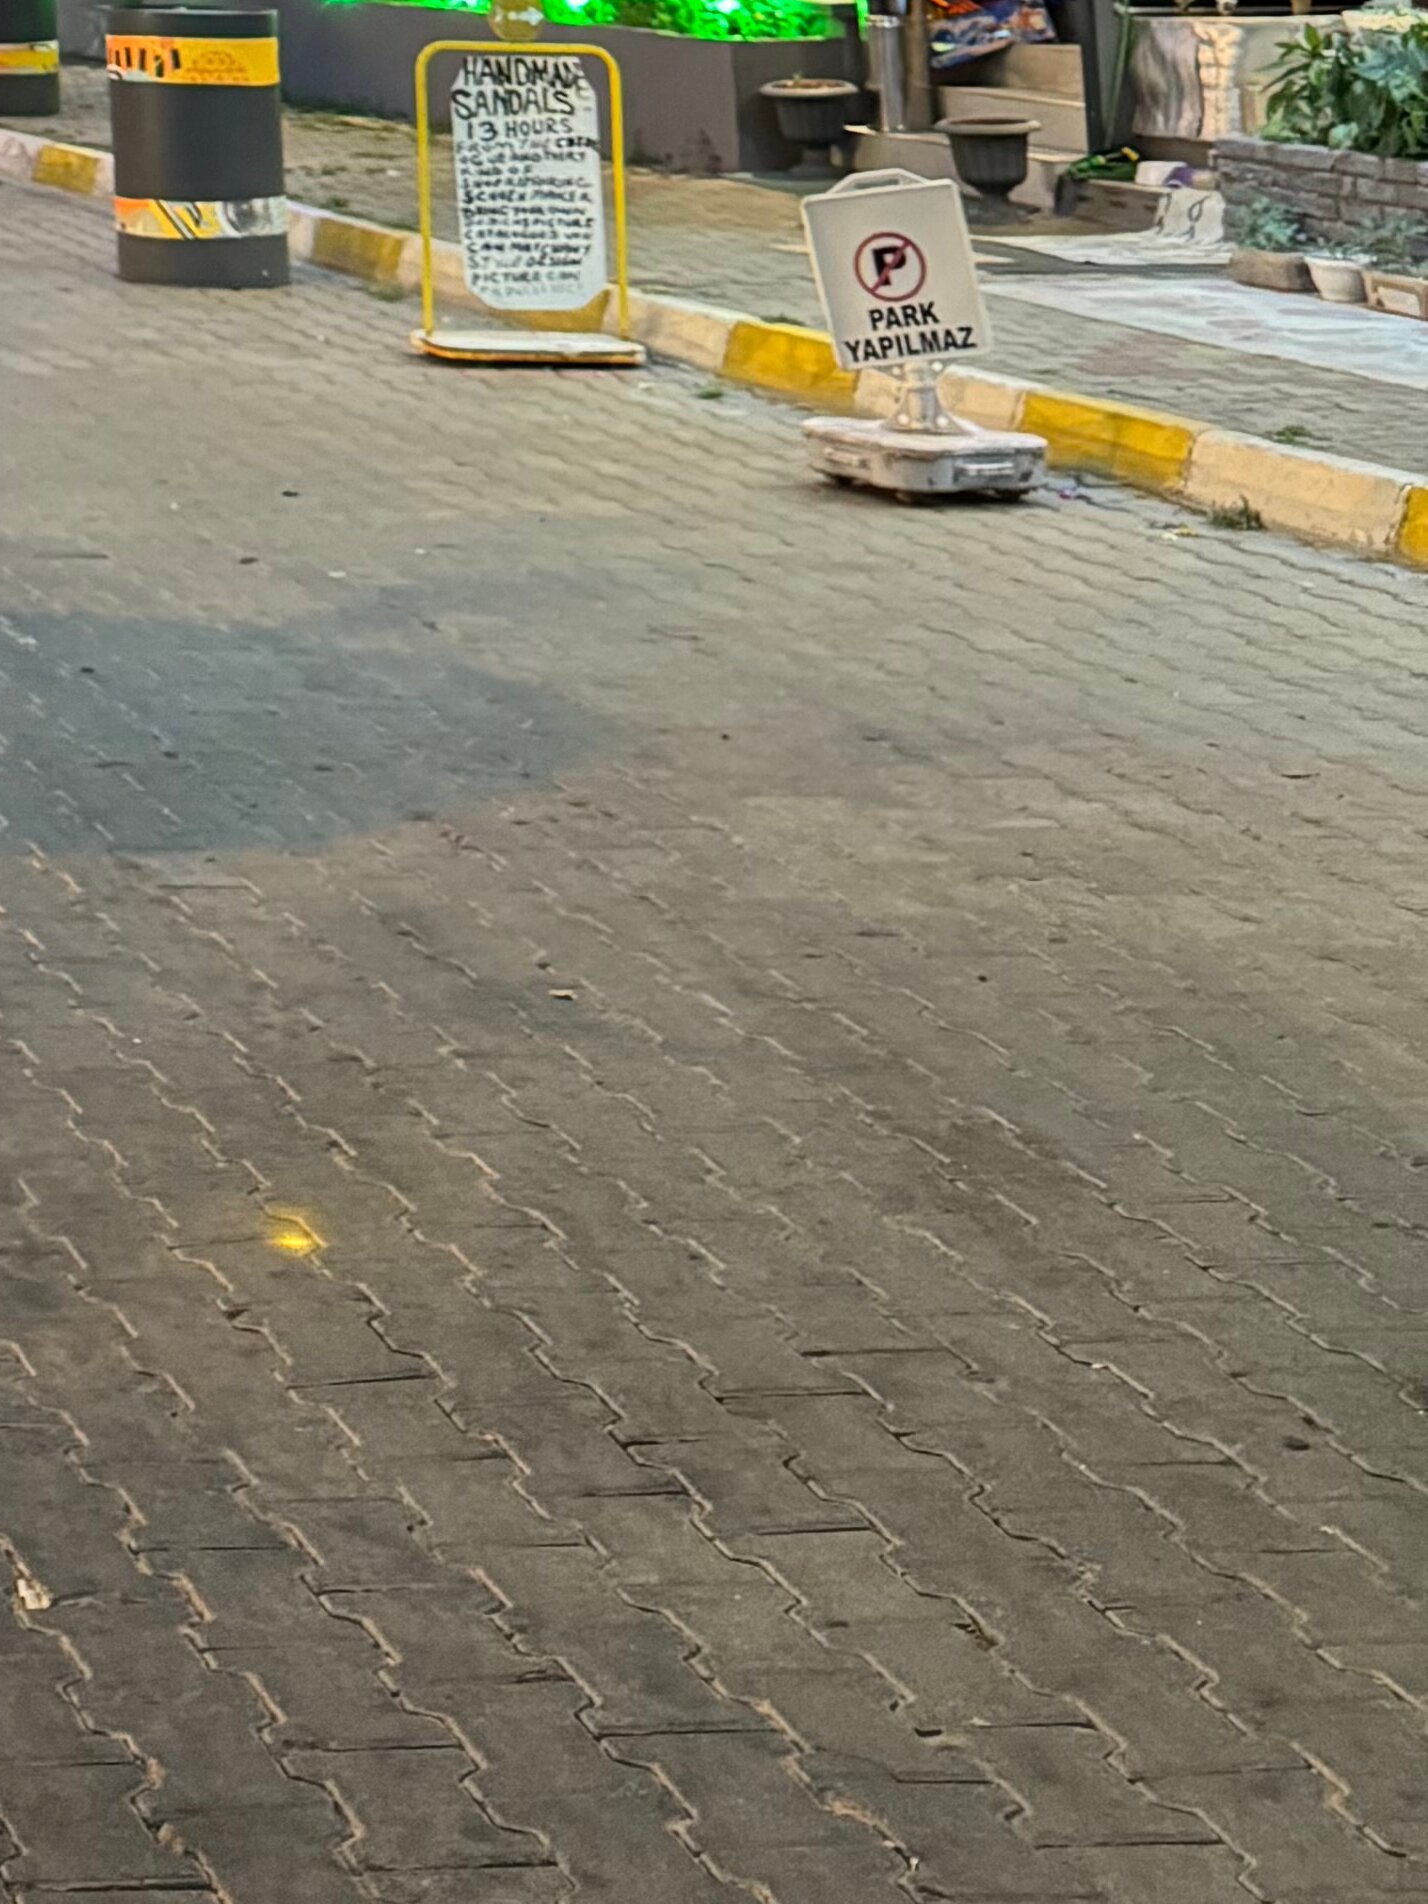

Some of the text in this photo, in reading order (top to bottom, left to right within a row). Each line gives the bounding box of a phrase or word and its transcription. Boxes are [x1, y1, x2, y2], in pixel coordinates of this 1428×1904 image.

[451, 88, 575, 120] SANDALS
[466, 117, 574, 142] 13 HOURS
[868, 301, 940, 331] PARK
[844, 326, 977, 362] YAPILMAZ
